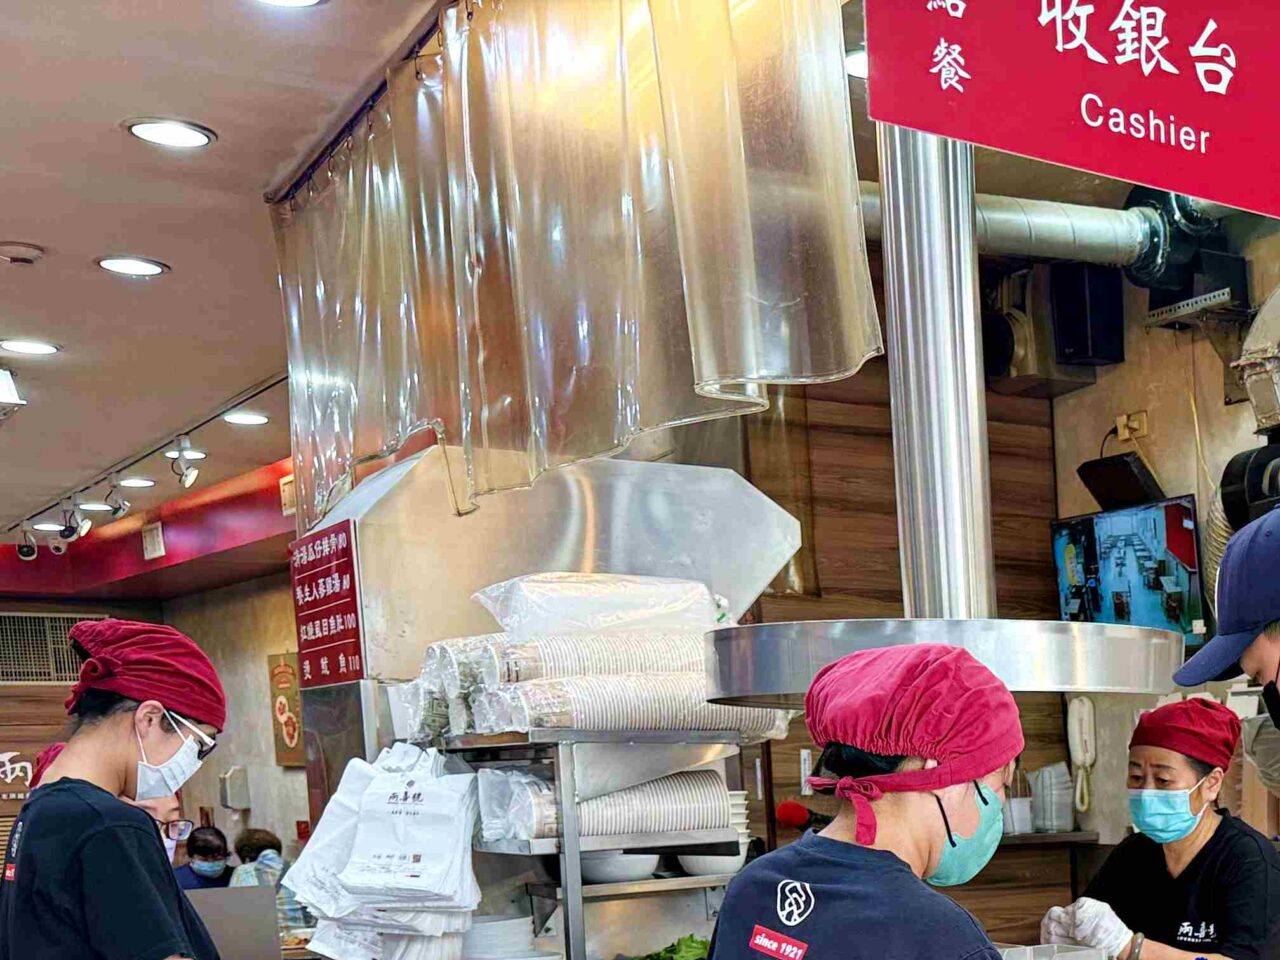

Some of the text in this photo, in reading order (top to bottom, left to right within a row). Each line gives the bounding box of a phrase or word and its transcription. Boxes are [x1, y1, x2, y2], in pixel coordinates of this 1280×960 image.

[1037, 0, 1237, 96] 收銀台
[1081, 93, 1210, 154] Cashier
[754, 933, 803, 960] since 1921
